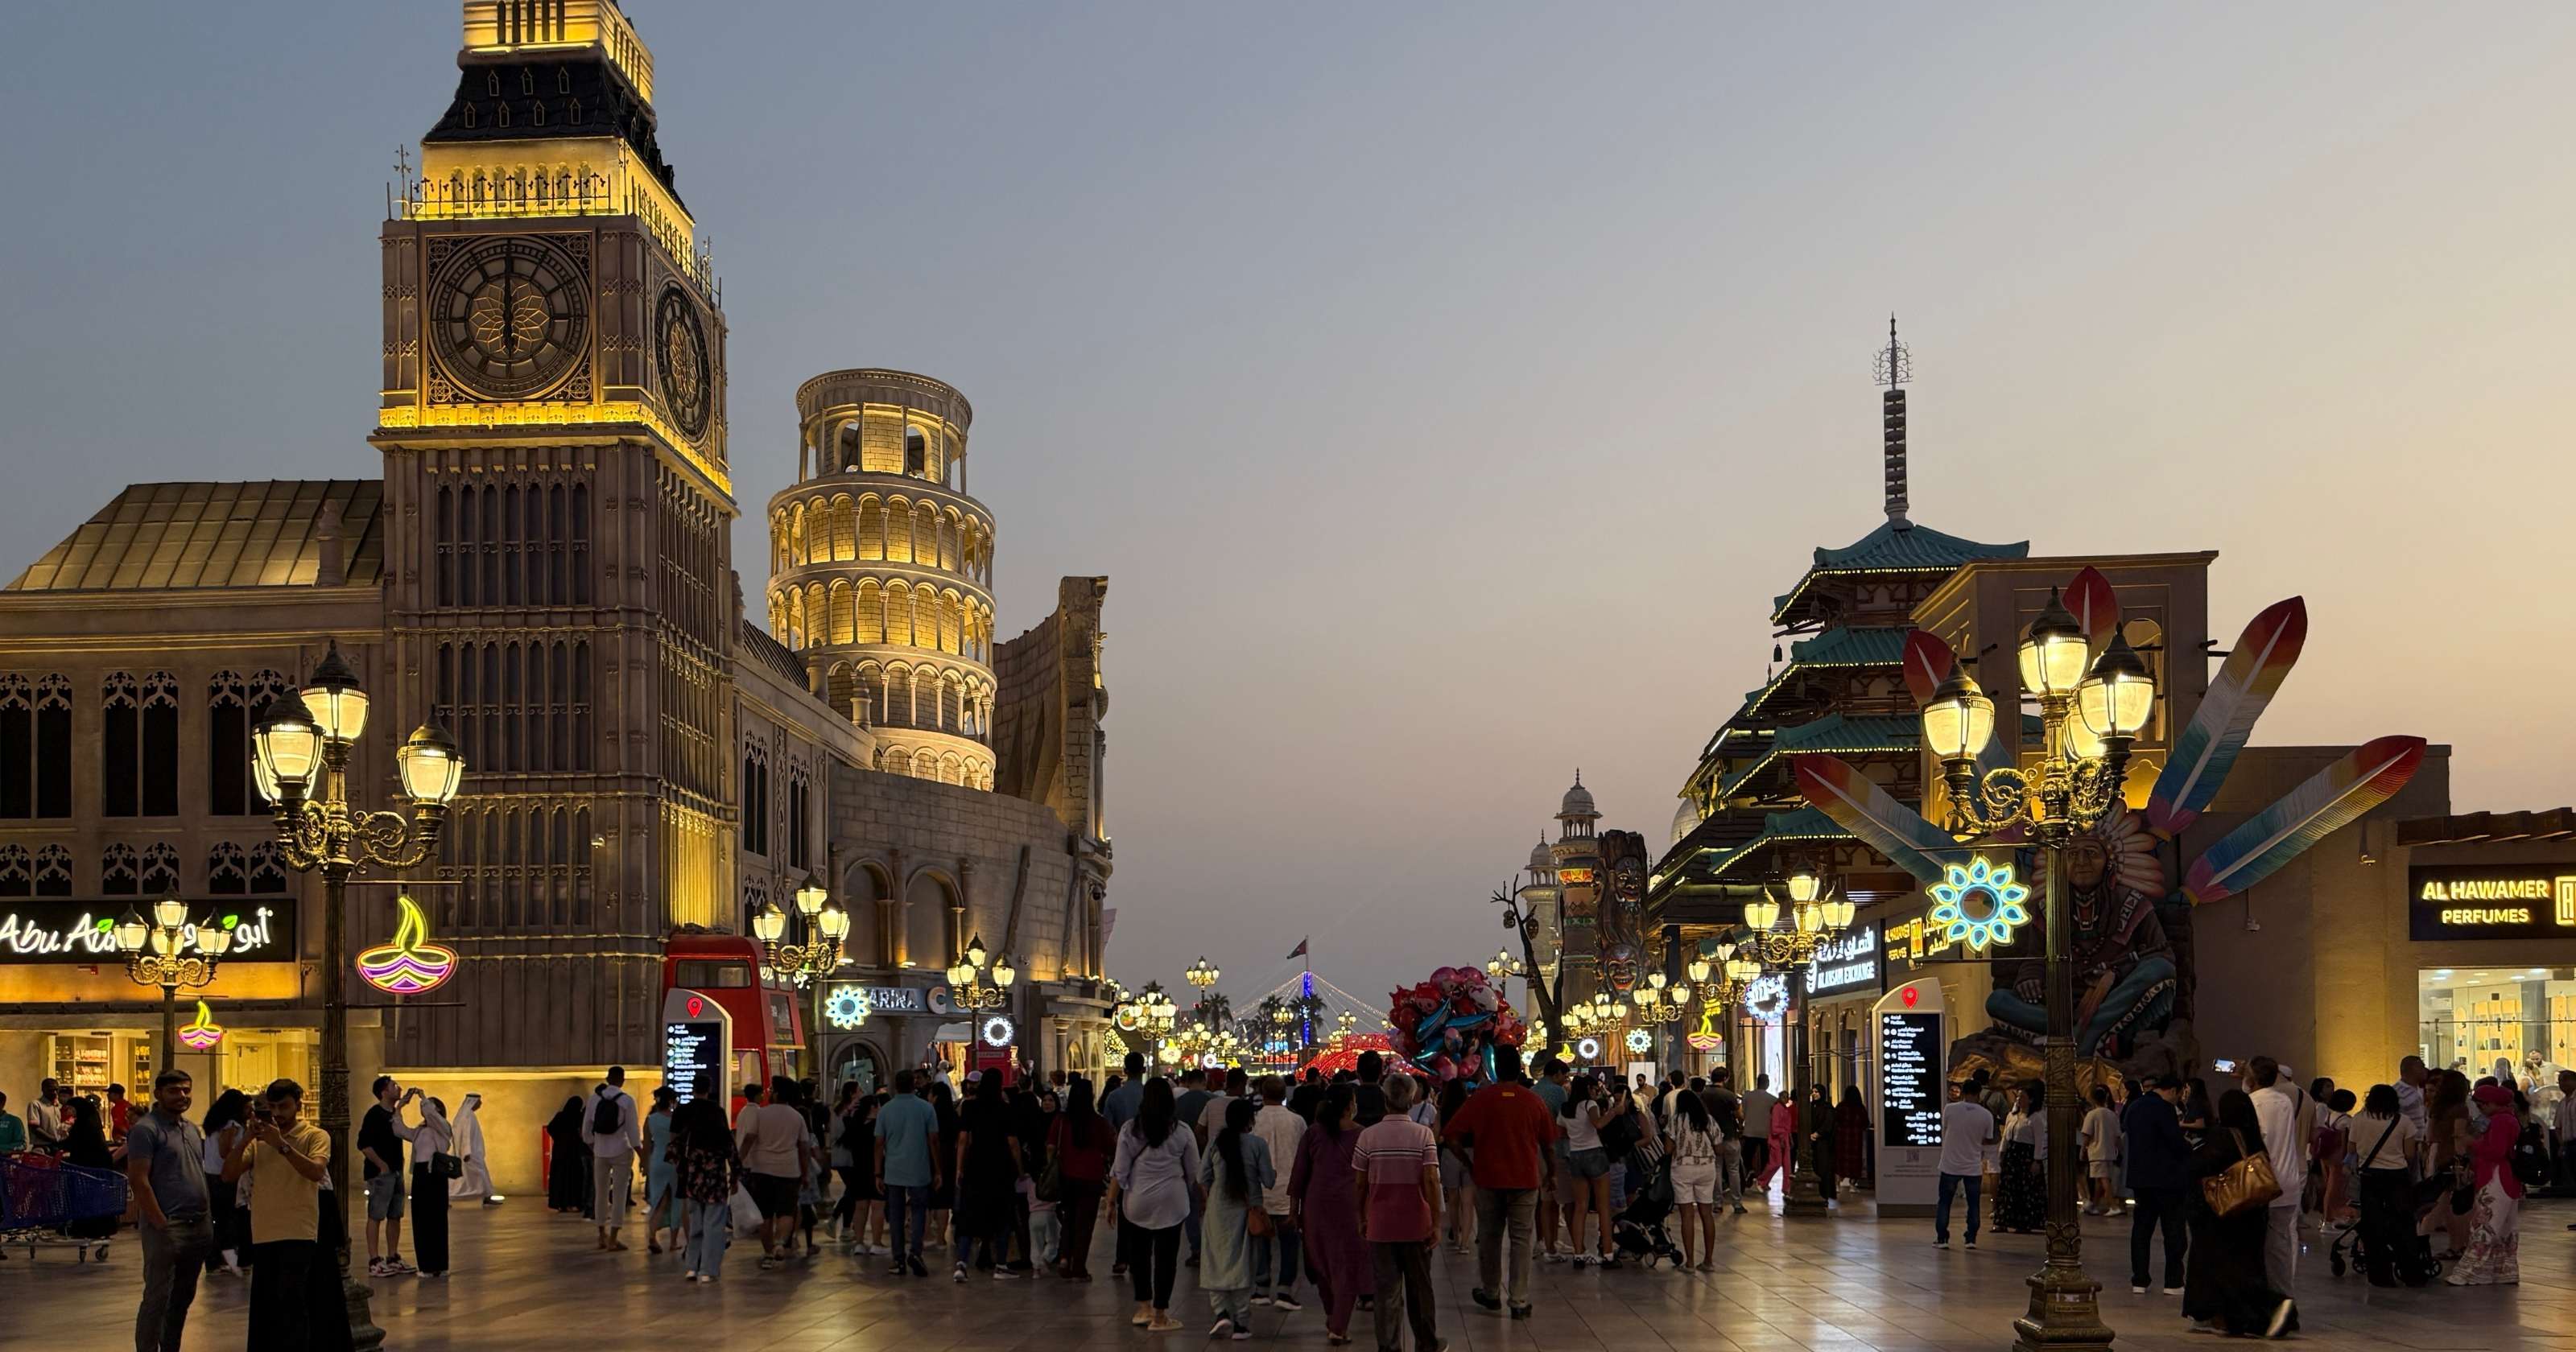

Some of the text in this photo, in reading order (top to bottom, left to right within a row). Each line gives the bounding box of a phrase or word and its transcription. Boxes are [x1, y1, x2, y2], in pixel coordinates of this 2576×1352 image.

[2422, 880, 2549, 900] AL HAWAMER
[2442, 908, 2531, 924] PERFUMES
[0, 912, 116, 953] Abu Au
[868, 988, 919, 1009] ARINA
